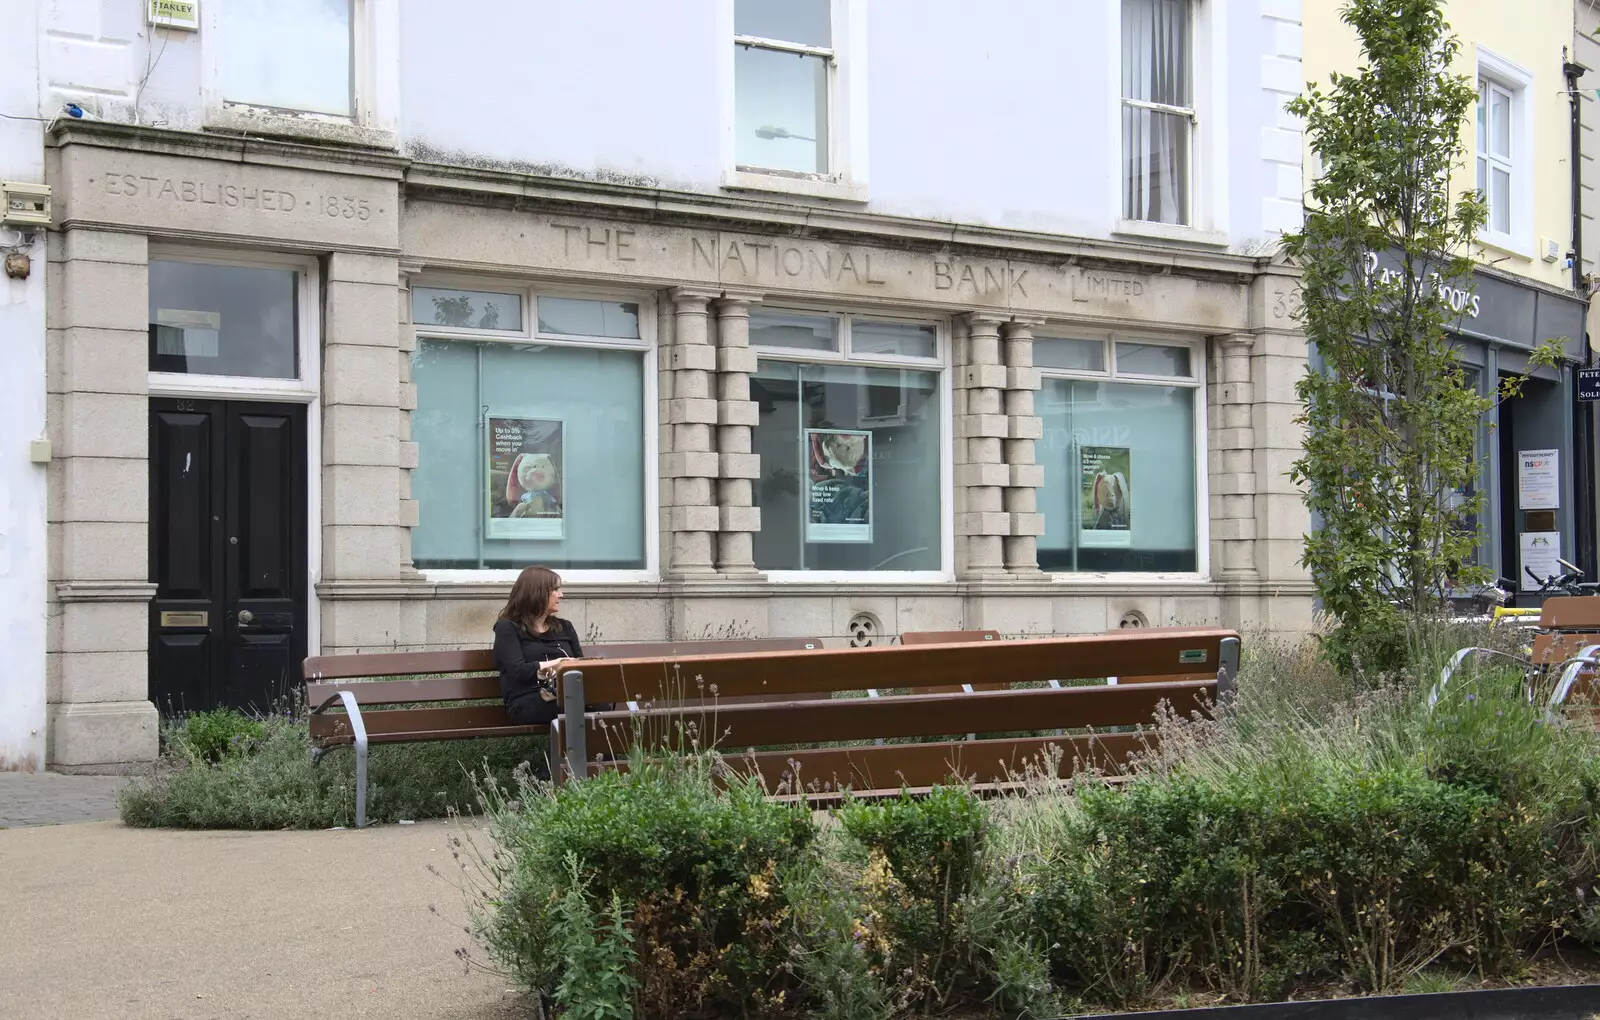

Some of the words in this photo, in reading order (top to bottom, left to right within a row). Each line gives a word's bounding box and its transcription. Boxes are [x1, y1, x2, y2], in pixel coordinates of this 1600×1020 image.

[153, 1, 192, 13] STANLEY
[104, 172, 297, 212] ESTABLISHED
[319, 195, 370, 221] 1835
[550, 223, 636, 262] THE
[691, 236, 885, 285] NATIONAL
[934, 260, 1029, 299] BANK
[177, 400, 196, 412] 32
[495, 427, 504, 435] Up
[512, 441, 523, 449] you
